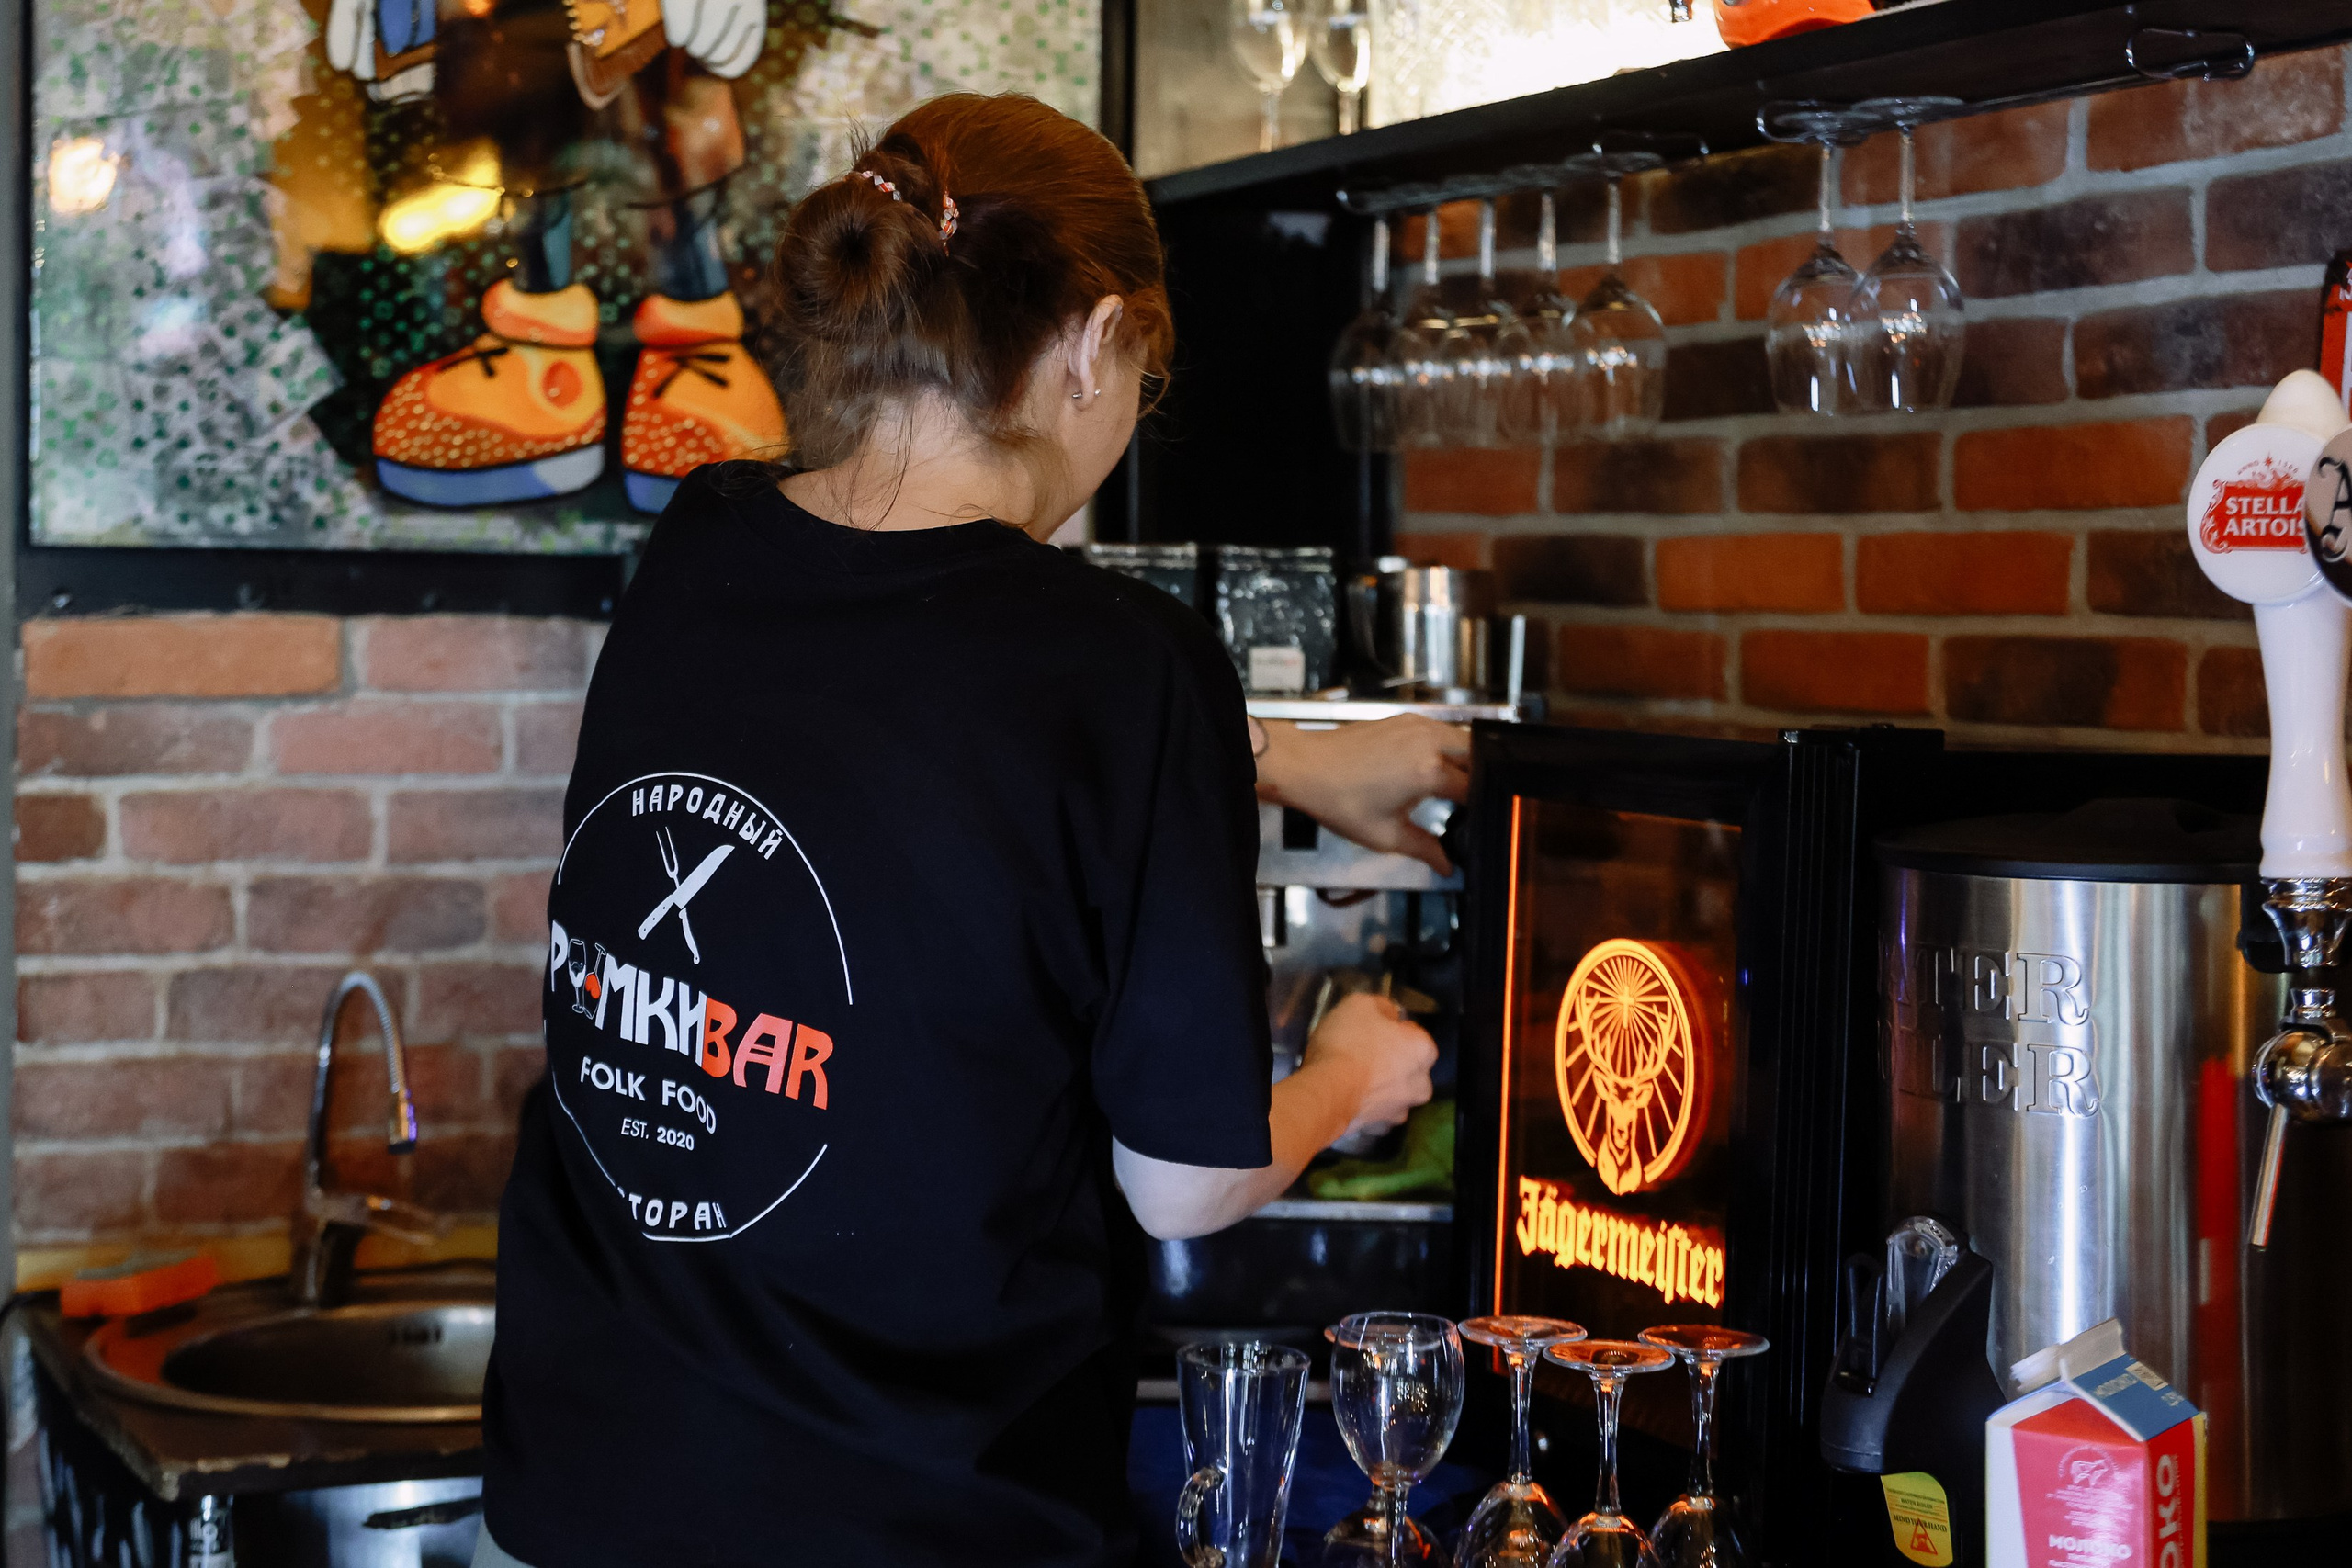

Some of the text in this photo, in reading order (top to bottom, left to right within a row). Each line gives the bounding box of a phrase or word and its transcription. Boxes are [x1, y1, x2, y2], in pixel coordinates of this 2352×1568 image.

[2224, 496, 2306, 515] STELLA
[632, 784, 784, 860] НАРОДНЫЙ
[1893, 944, 2090, 1026] TER
[580, 1056, 717, 1134] FOLK FOOD
[620, 1117, 695, 1151] EST. 2020
[619, 1190, 728, 1231] ТОРАН
[1516, 1175, 1724, 1309] Jägermeister
